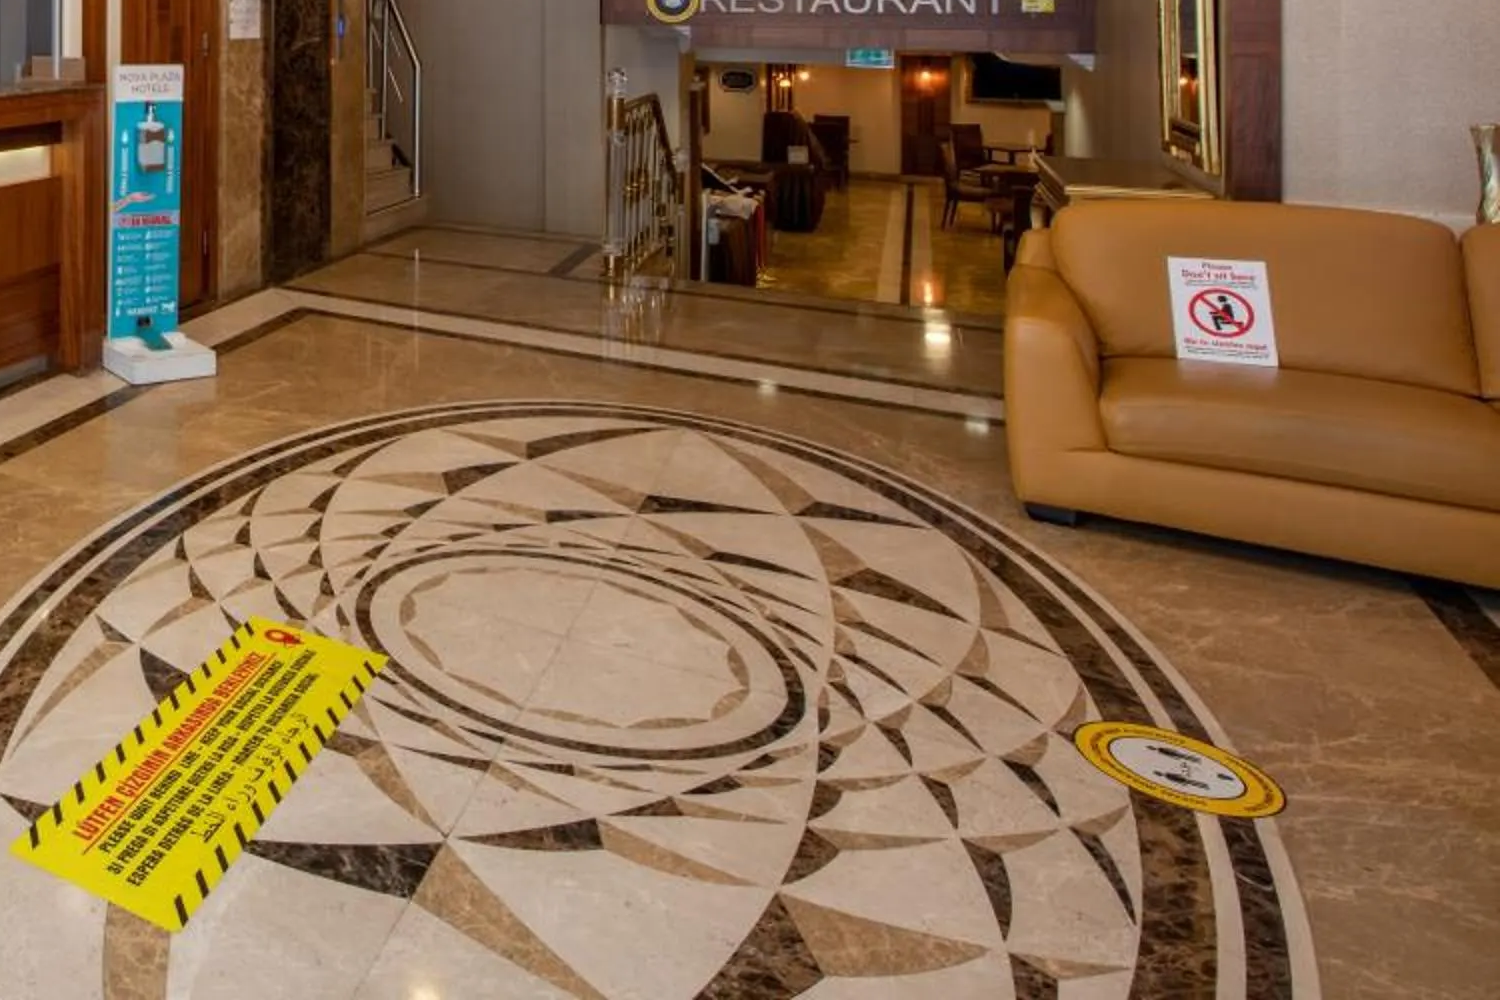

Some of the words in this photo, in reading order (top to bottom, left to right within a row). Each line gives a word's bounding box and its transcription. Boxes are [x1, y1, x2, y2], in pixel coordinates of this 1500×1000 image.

[98, 819, 135, 853] PLEASE
[128, 798, 154, 820] WAIT
[149, 770, 182, 800] BEHIND
[179, 750, 200, 768] LINE
[199, 727, 221, 746] KEEP
